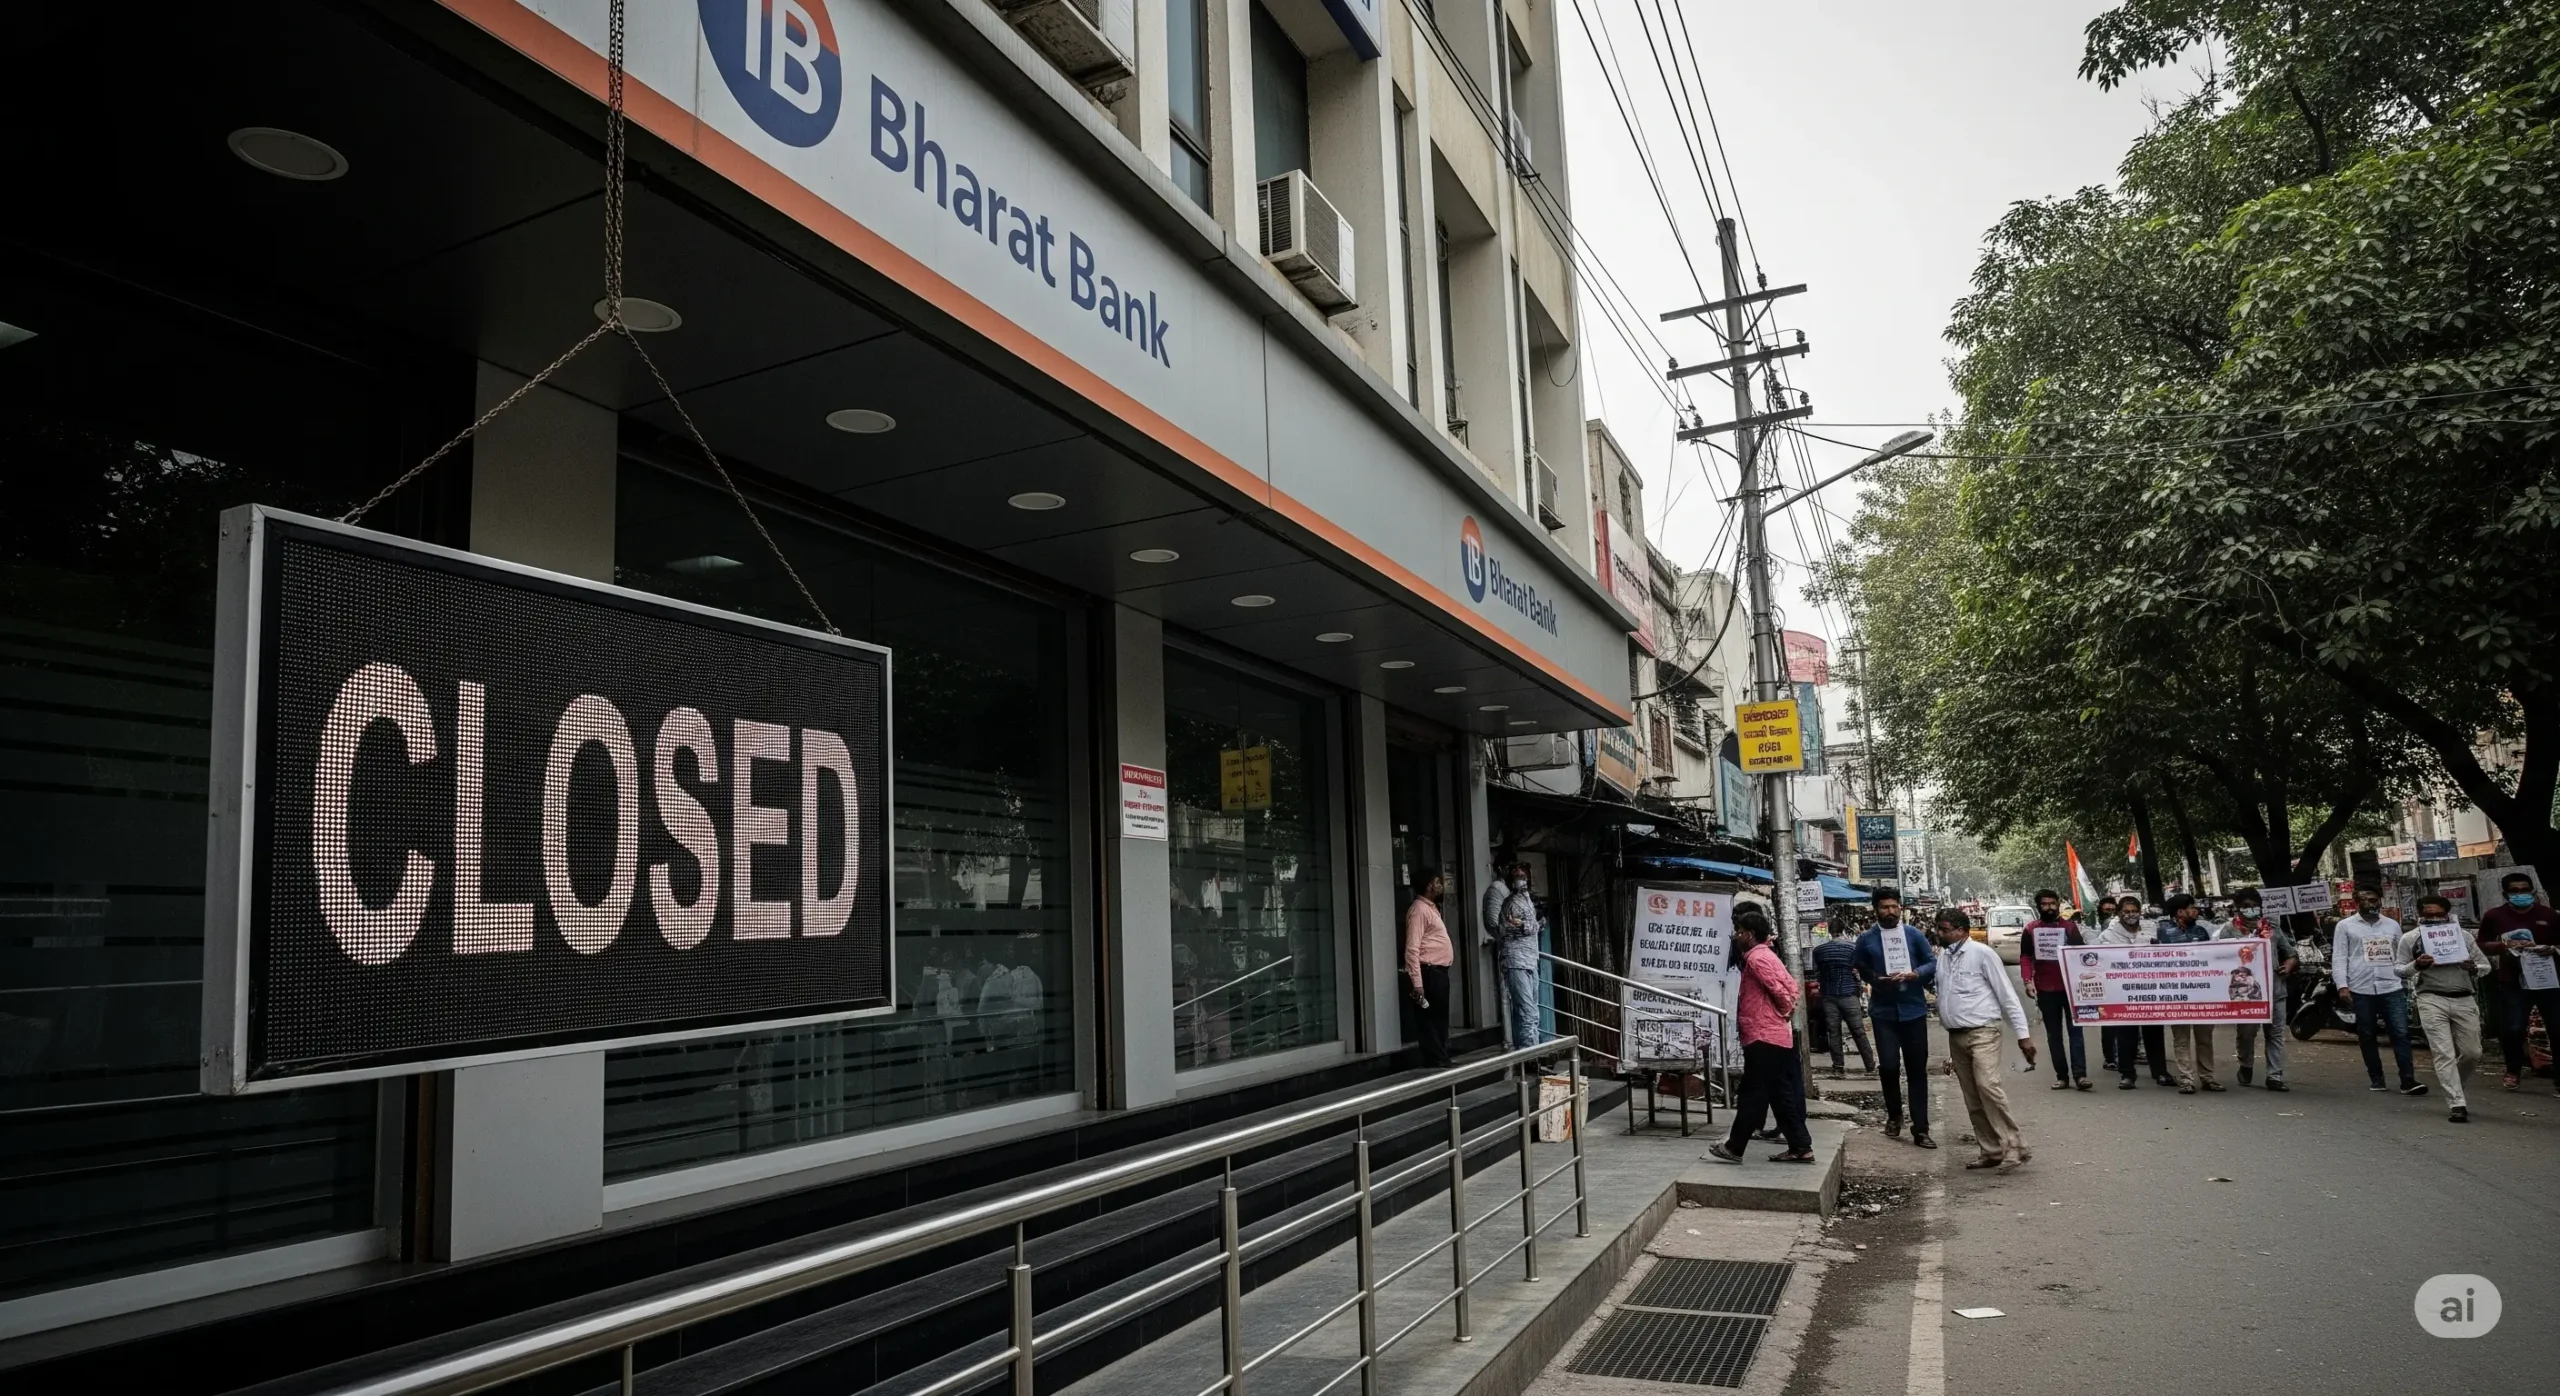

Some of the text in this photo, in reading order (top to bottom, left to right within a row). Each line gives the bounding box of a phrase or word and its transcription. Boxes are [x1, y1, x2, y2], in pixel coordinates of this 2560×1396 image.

[870, 74, 1171, 369] Bharat Bank
[1489, 557, 1558, 638] Bharat Bank
[312, 661, 859, 966] CLOSED
